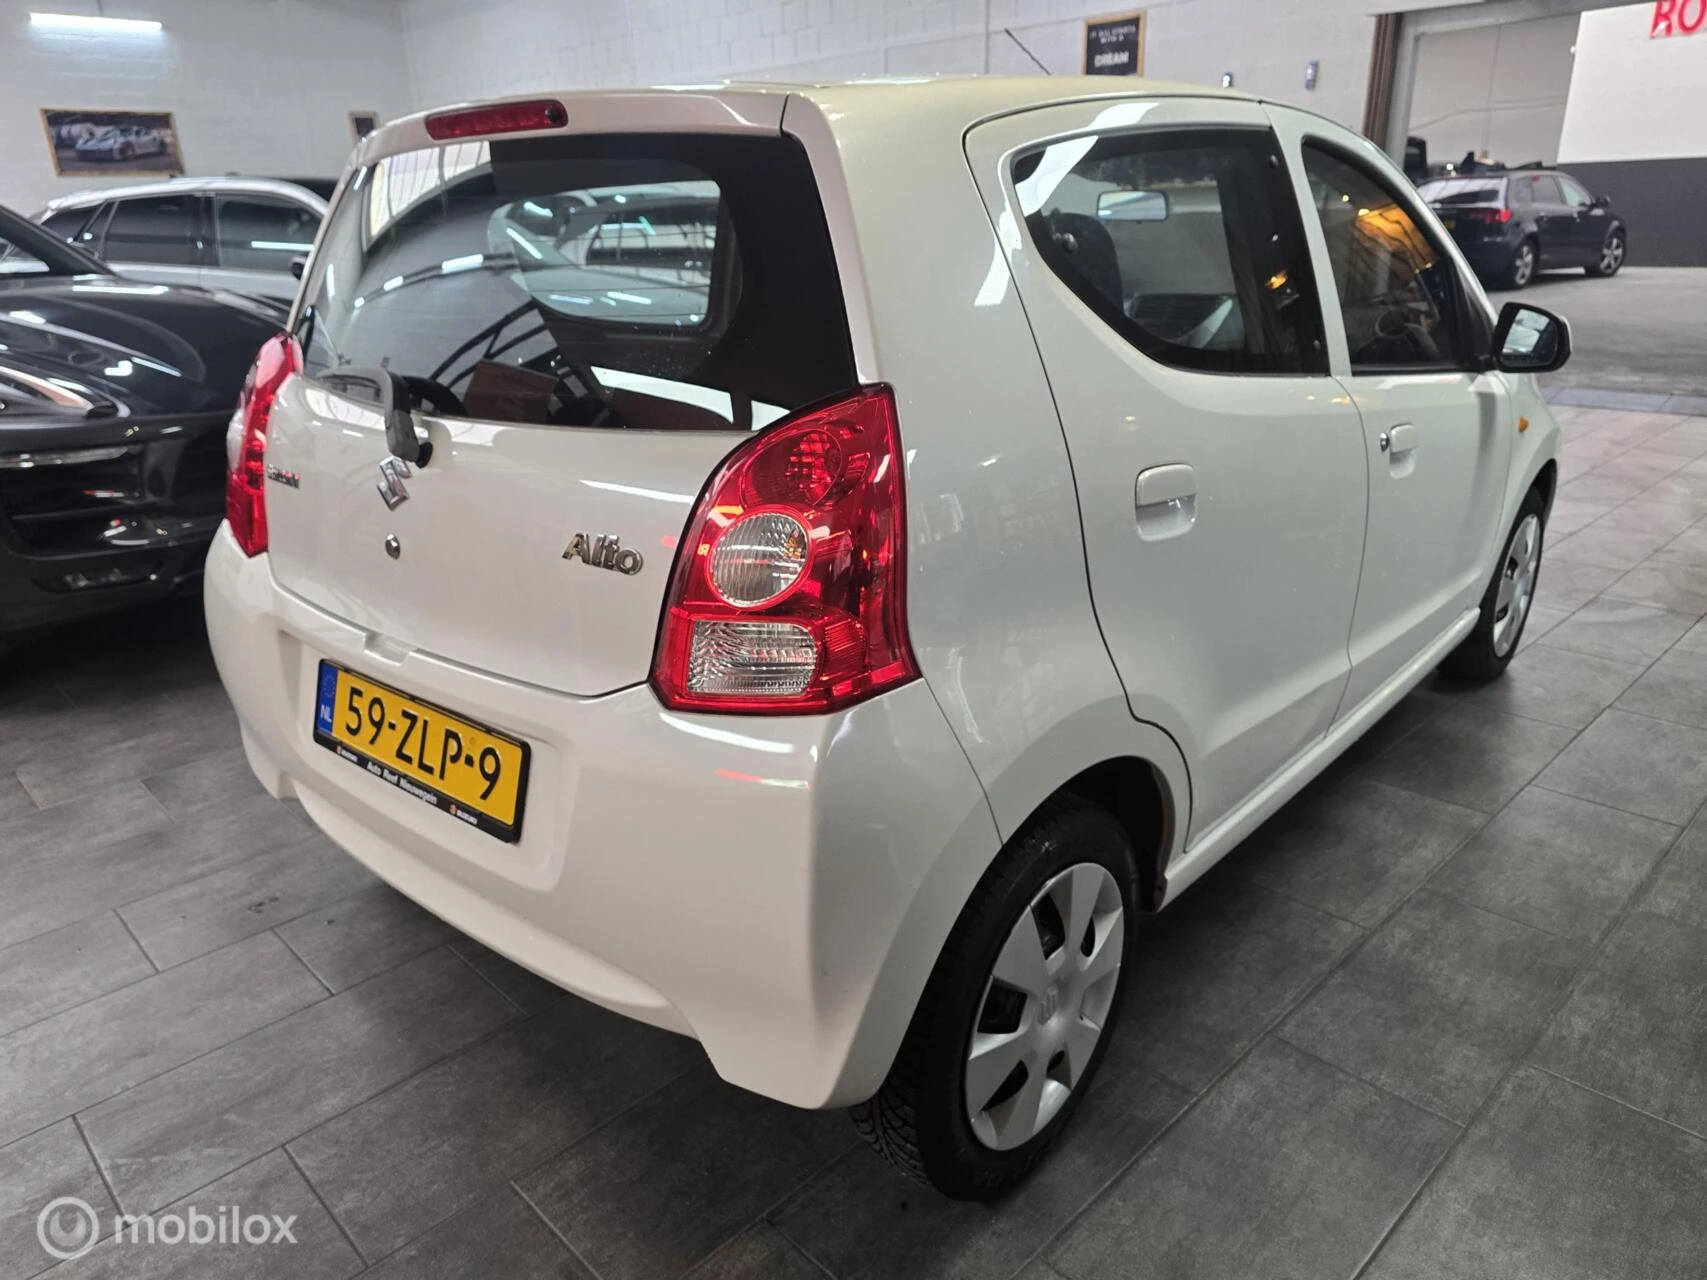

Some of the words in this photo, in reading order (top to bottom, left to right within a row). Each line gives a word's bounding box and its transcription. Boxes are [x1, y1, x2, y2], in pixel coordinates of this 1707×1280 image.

[562, 533, 644, 576] Alto
[320, 703, 332, 723] NL
[345, 686, 502, 801] 59-ZLP-9
